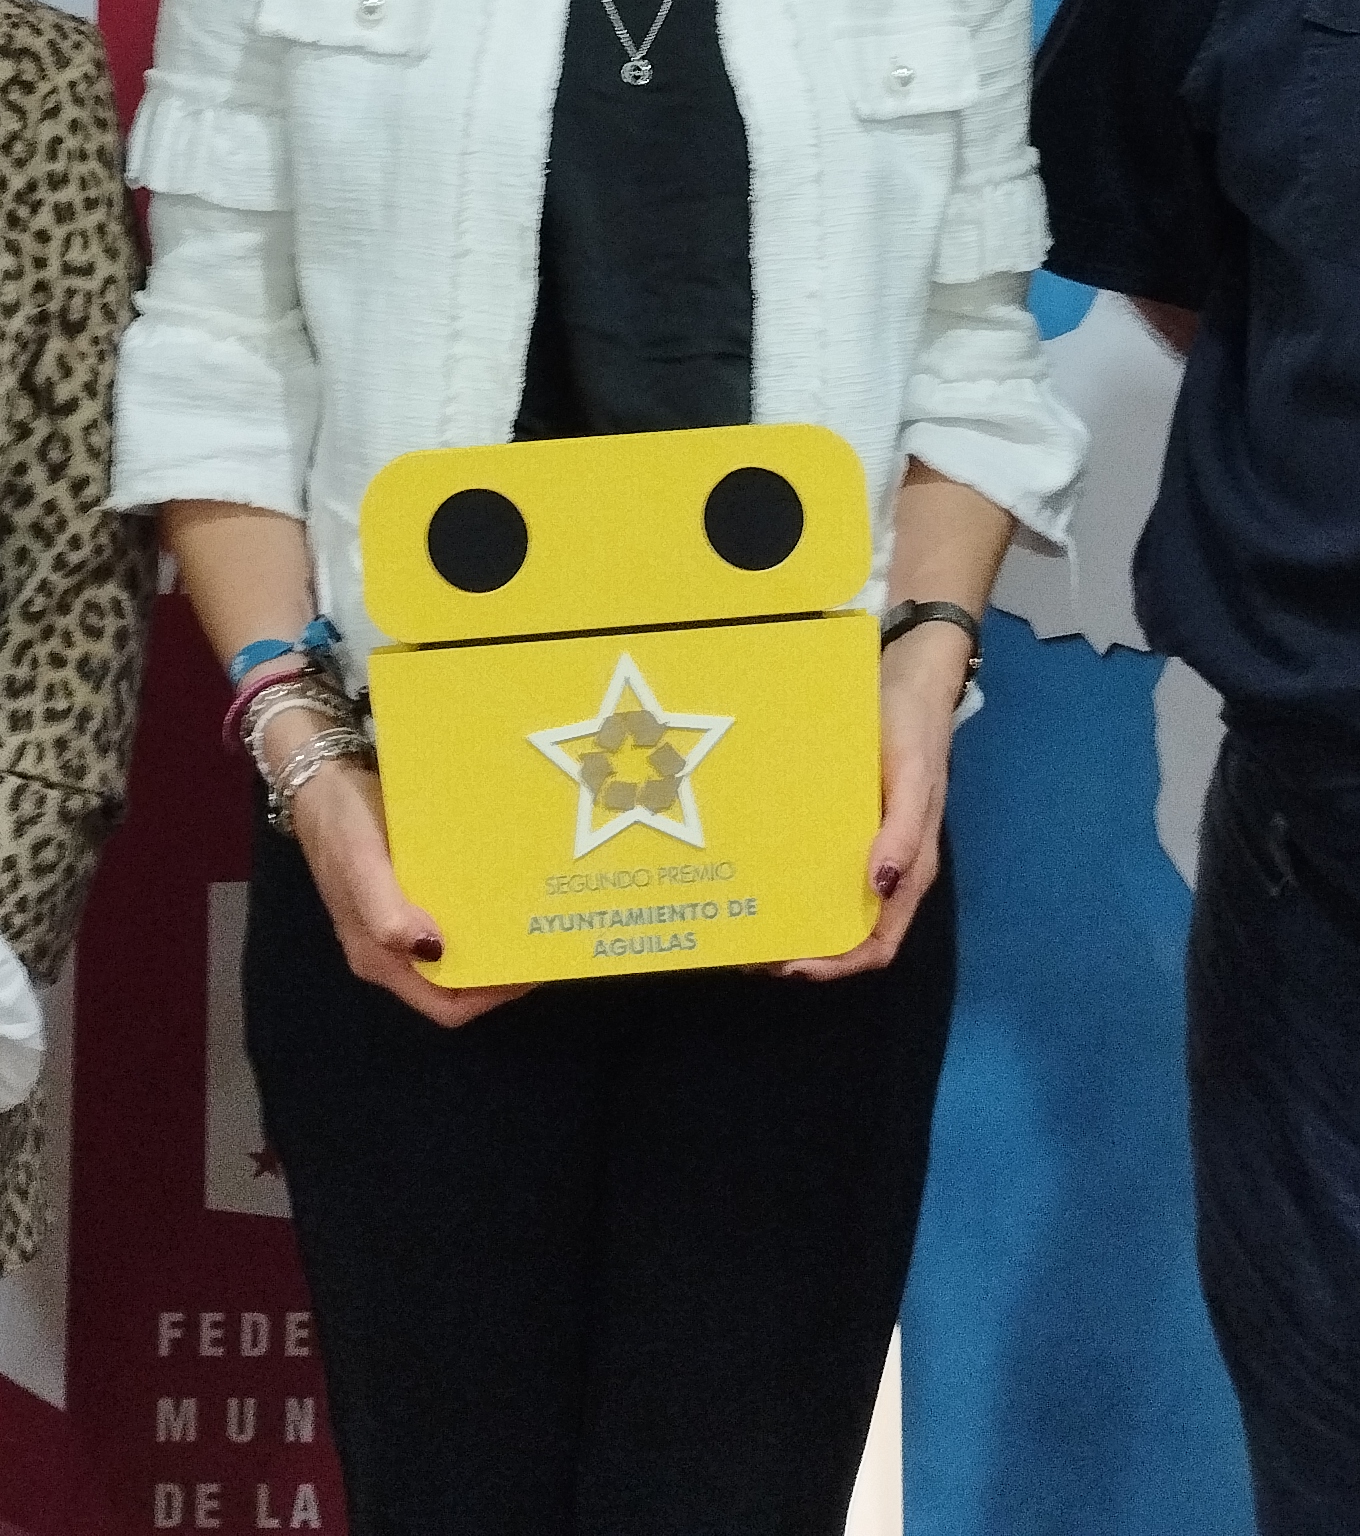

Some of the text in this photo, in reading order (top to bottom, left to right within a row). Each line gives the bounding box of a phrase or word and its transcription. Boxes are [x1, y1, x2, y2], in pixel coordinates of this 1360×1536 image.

[545, 861, 737, 896] SEGUNDO PREMIO
[527, 897, 758, 935] AYUNTAMIENTO DE
[592, 931, 698, 958] AGUILAS
[156, 1311, 313, 1357] FEDE
[155, 1397, 316, 1443] MUN
[153, 1482, 322, 1529] DE LA
